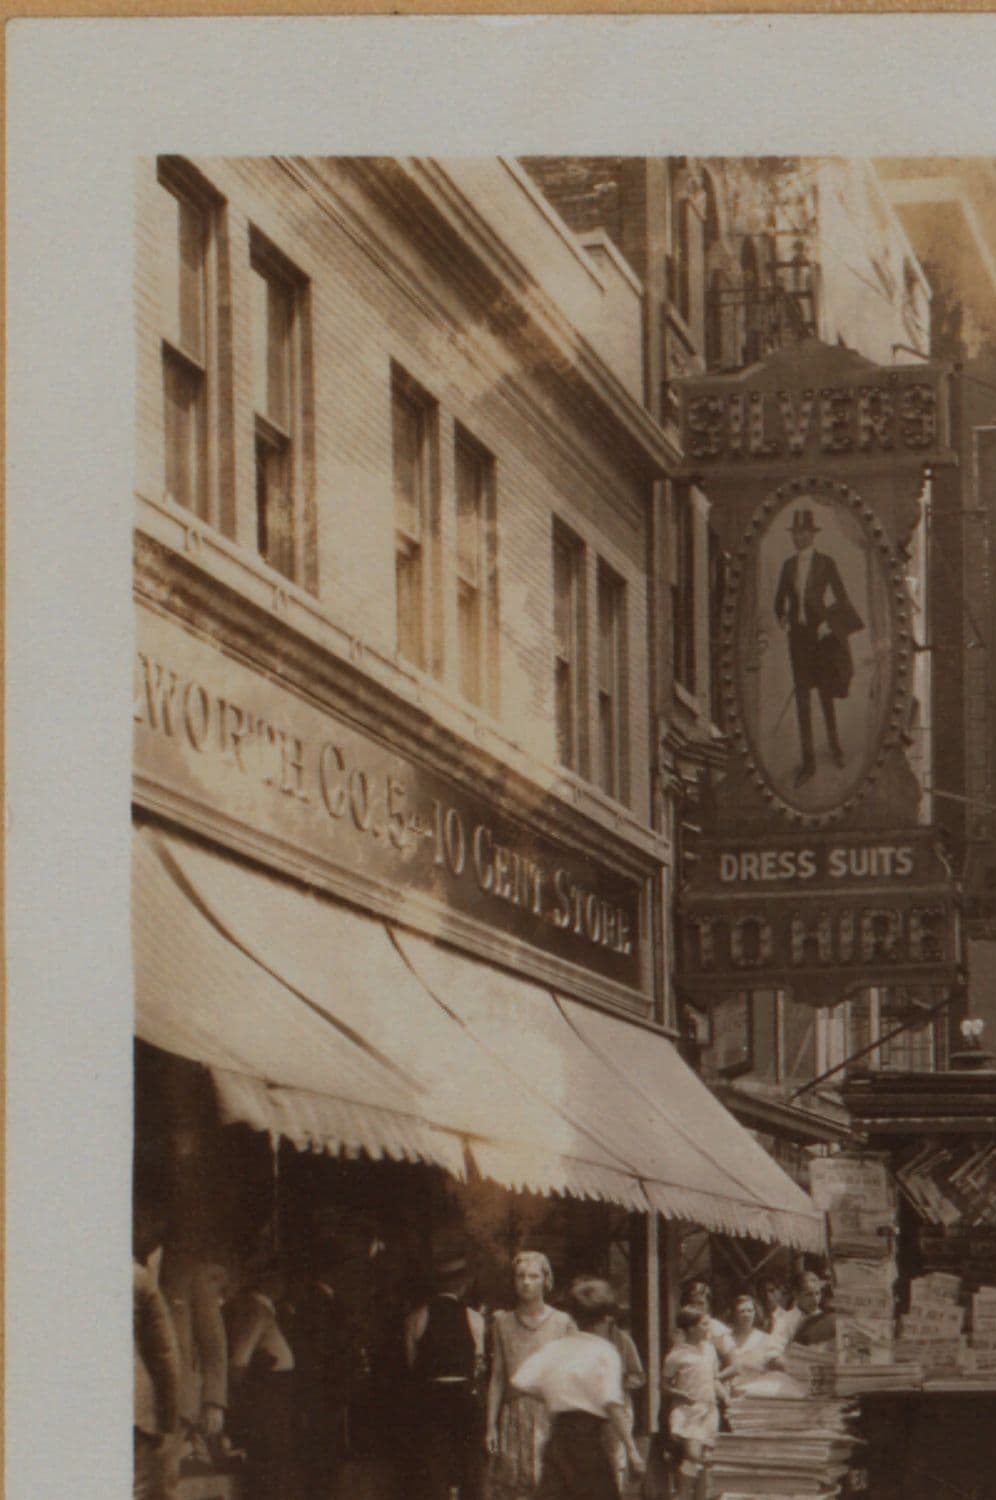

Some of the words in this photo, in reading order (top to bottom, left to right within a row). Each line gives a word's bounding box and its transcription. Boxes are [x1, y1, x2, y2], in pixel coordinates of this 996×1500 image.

[133, 651, 310, 804] WORTH
[432, 799, 465, 876] 10
[719, 850, 817, 882] DRESS
[828, 845, 914, 878] SUITS
[690, 912, 772, 968] TO
[790, 905, 946, 965] HIRE
